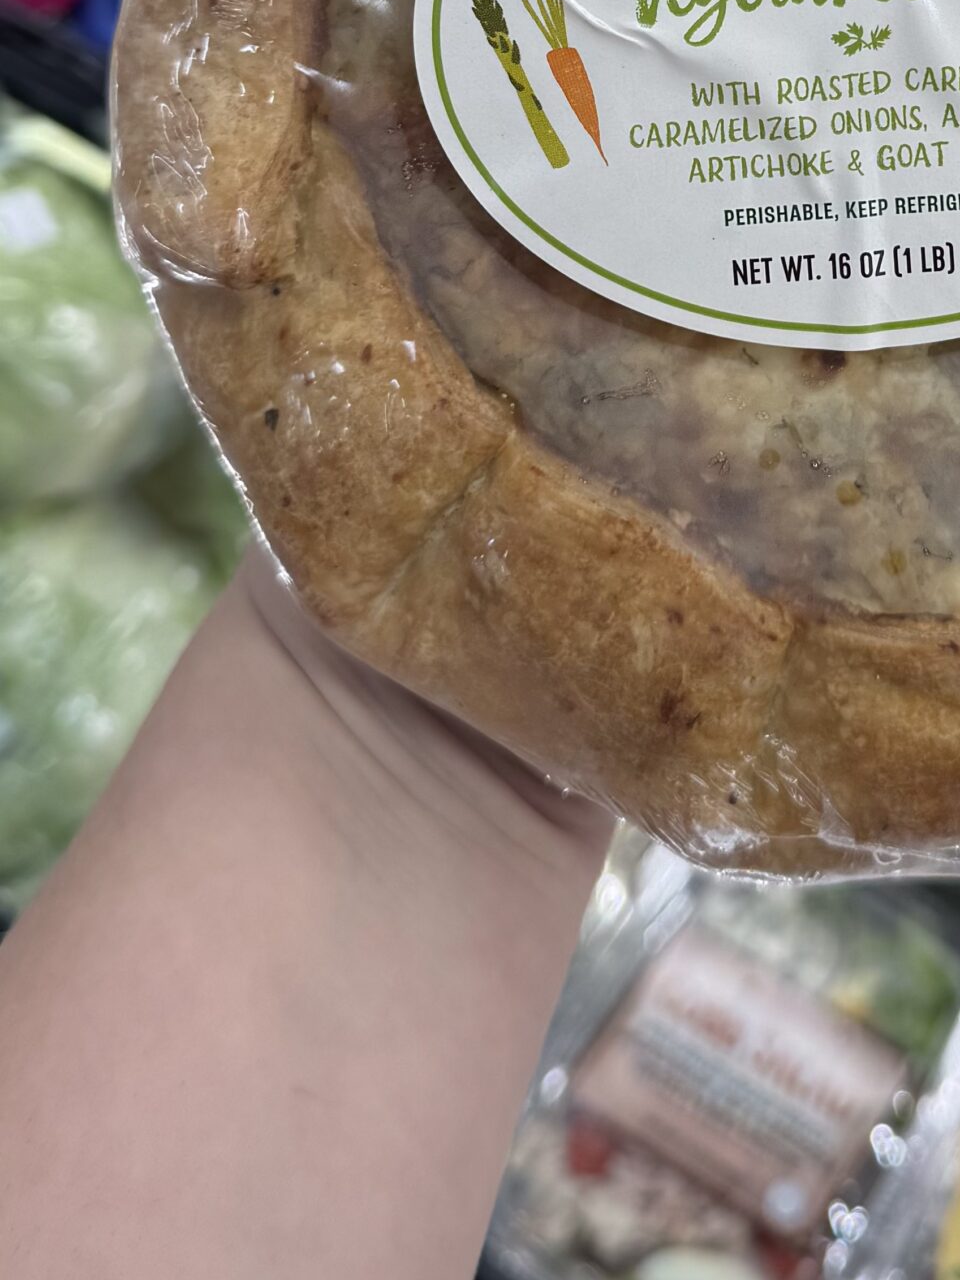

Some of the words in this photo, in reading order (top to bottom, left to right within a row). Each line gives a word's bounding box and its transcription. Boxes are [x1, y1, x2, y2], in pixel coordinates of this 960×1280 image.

[691, 81, 761, 107] WITH
[777, 70, 892, 105] ROASTED
[629, 115, 818, 149] CARAMELIZED
[831, 104, 928, 135] ONIONS,
[689, 150, 835, 183] ARTICHOKE
[847, 149, 865, 176] &
[876, 140, 950, 171] GOAT
[724, 202, 839, 227] PERISHABLE,
[845, 198, 889, 219] KEEP
[732, 257, 773, 286] NET
[780, 253, 822, 282] WT.
[828, 251, 851, 280] 16
[859, 249, 886, 278] OZ
[893, 245, 913, 278] (1
[920, 241, 955, 274] LB)
